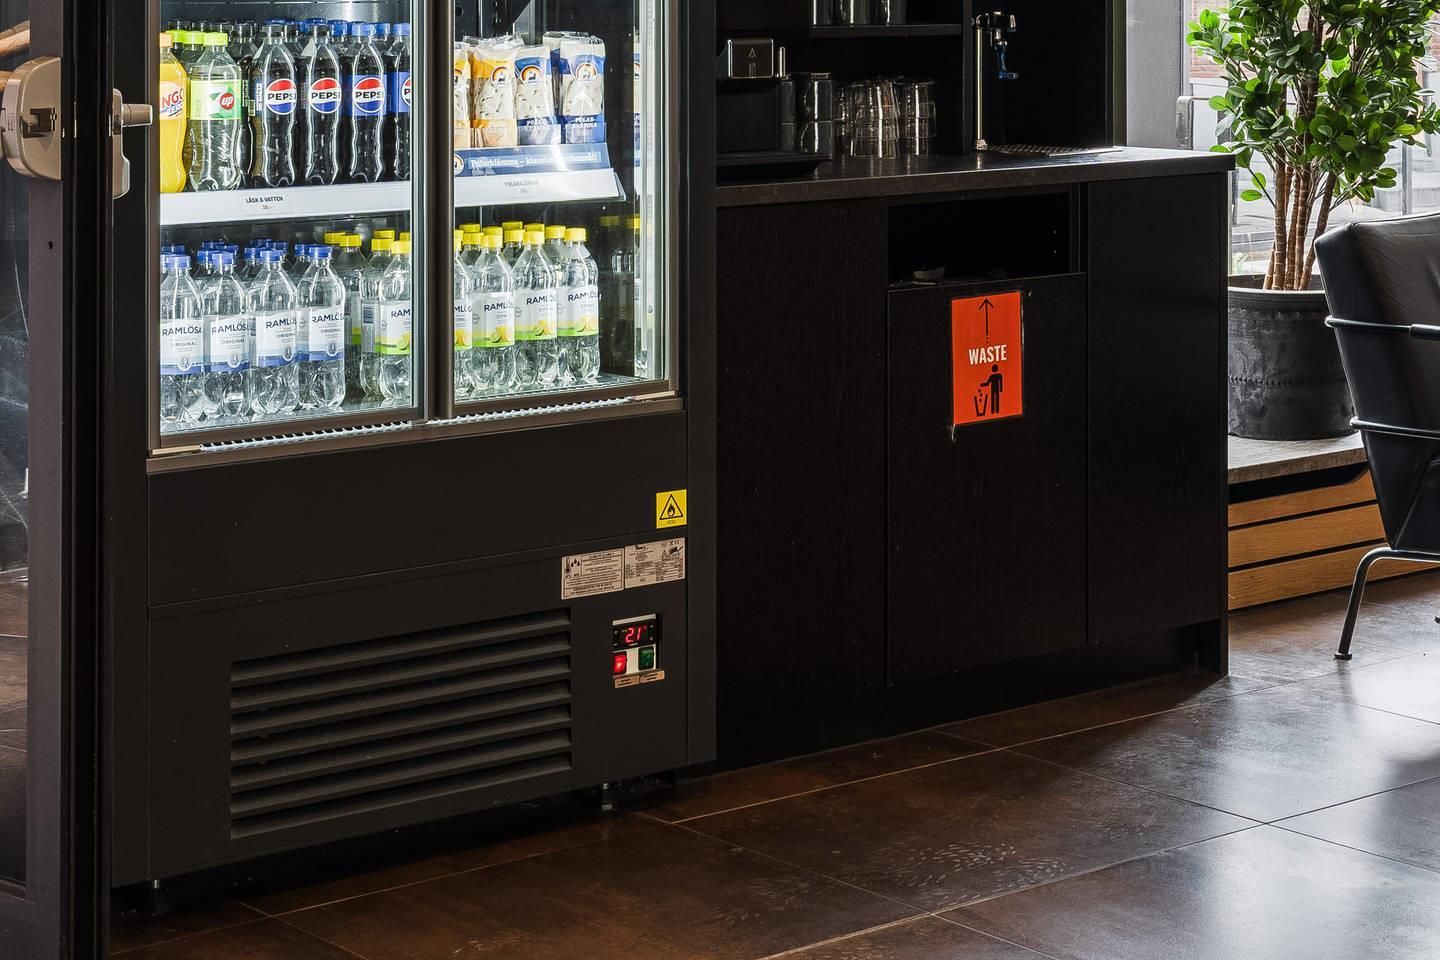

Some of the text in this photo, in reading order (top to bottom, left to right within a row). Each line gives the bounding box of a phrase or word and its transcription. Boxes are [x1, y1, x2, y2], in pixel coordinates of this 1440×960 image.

[245, 196, 259, 204] LÄSK
[263, 195, 284, 203] VATTEN
[968, 344, 1008, 366] WASTE
